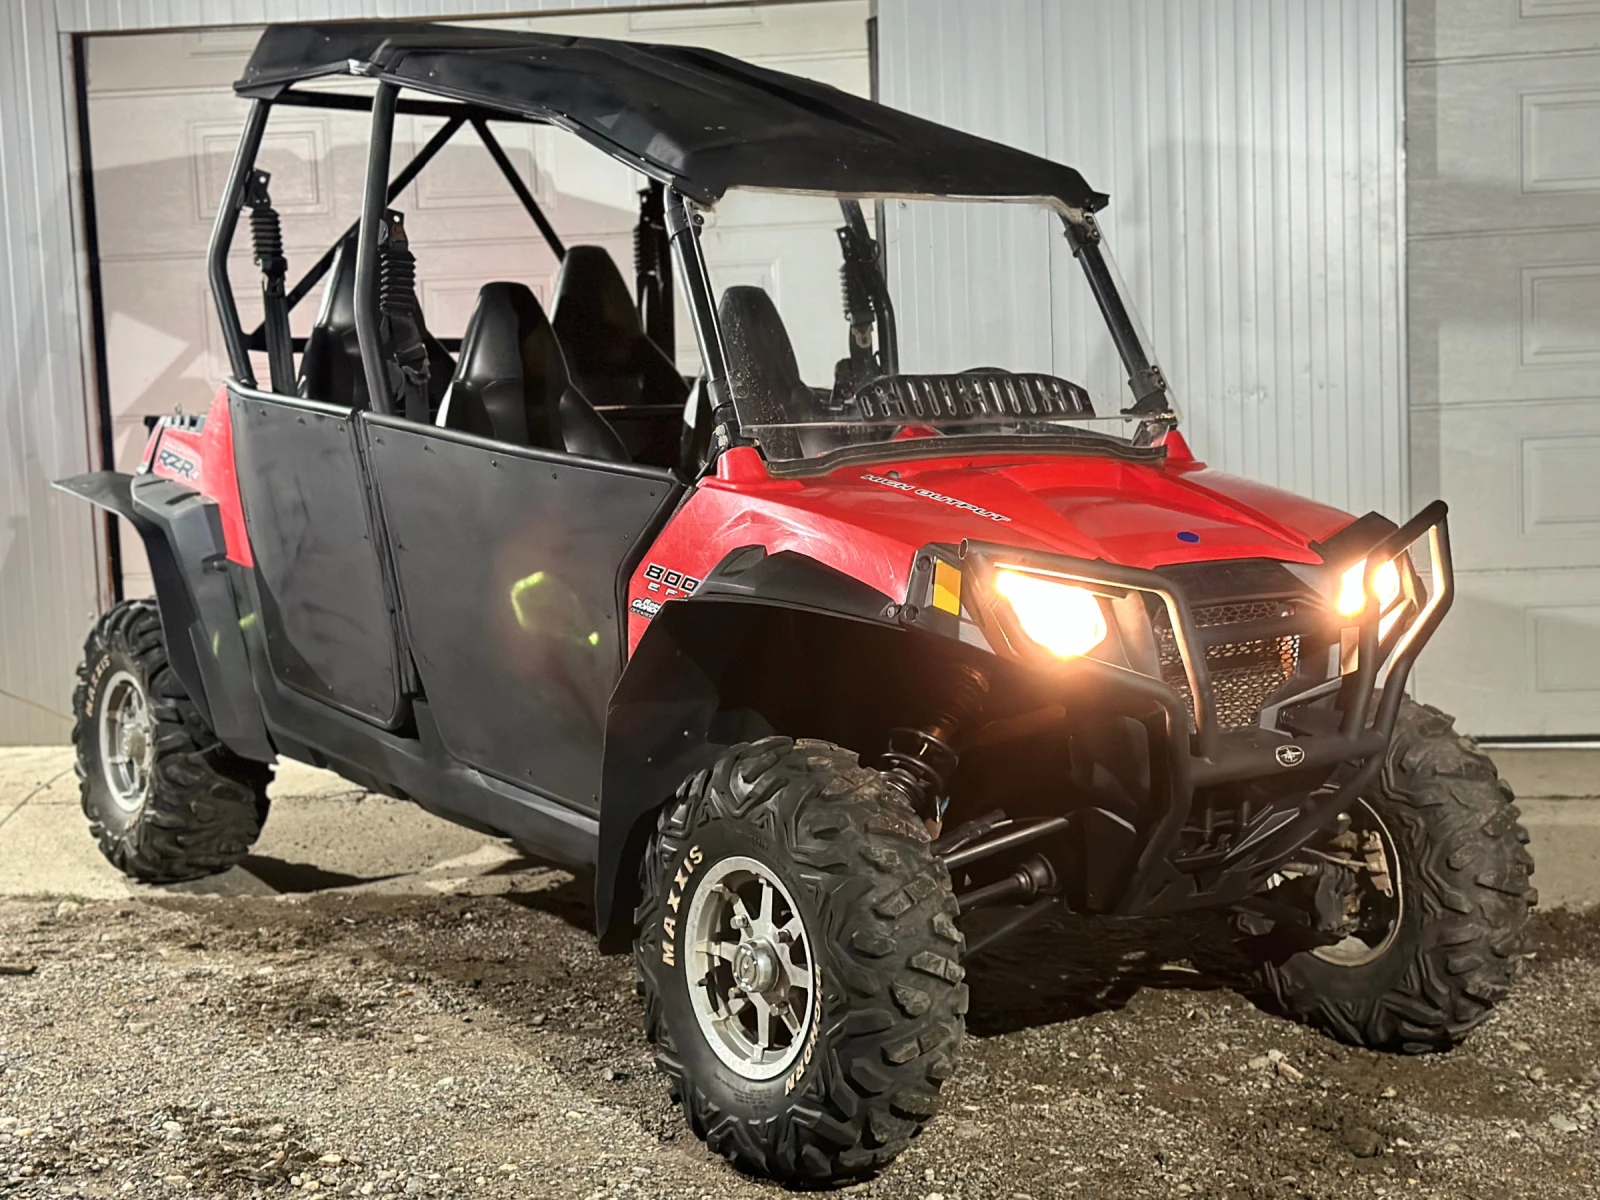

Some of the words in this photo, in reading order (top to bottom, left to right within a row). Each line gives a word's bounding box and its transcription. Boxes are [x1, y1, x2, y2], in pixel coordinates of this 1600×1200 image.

[159, 449, 194, 479] RZR
[860, 474, 915, 491] HIGH
[914, 489, 1012, 522] OUTPUT
[643, 562, 701, 593] 800
[86, 654, 111, 718] MAXXIS
[662, 845, 704, 967] MAXXIS
